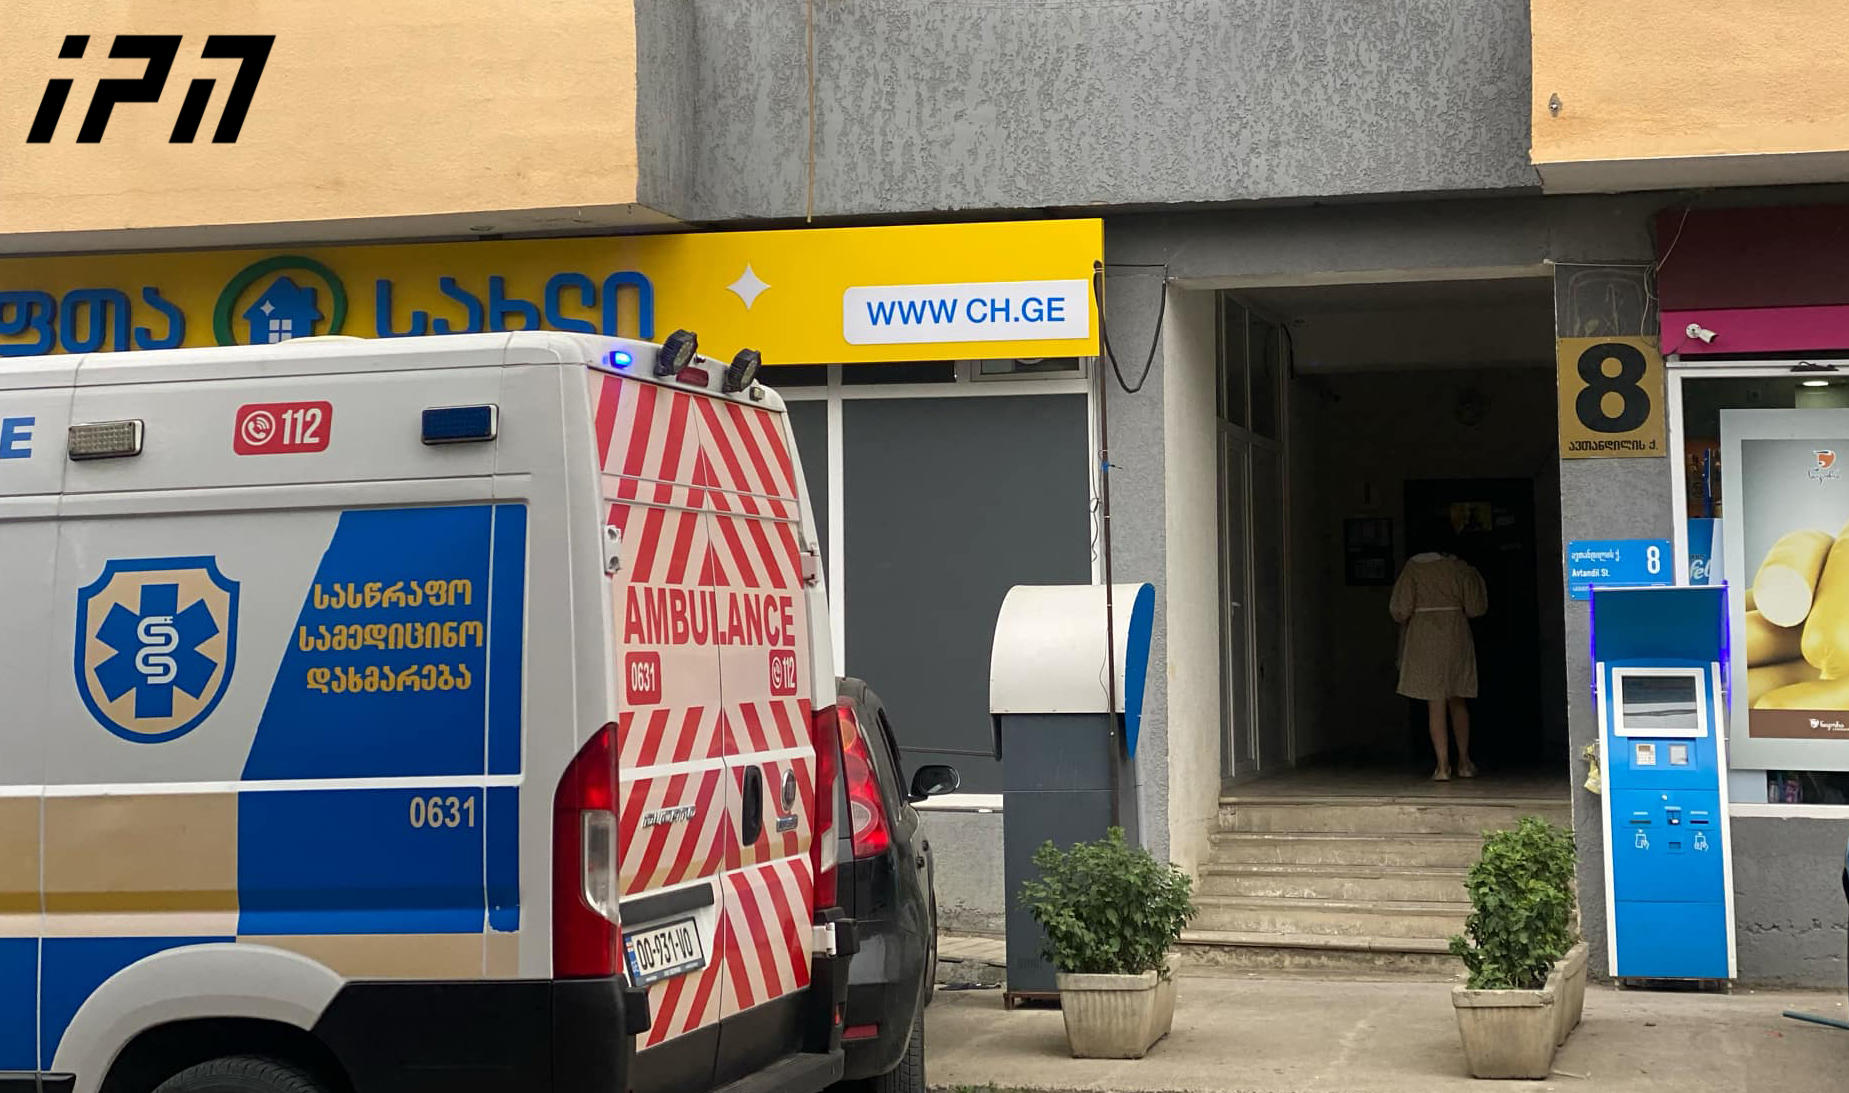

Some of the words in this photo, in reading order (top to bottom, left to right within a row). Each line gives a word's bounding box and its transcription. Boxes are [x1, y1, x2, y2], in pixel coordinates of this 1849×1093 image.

[376, 271, 654, 339] სახლი
[1575, 343, 1651, 433] 8
[281, 408, 322, 445] 112
[1569, 440, 1646, 451] ავთანდილის
[1572, 568, 1600, 577] Avtandil
[1646, 545, 1661, 575] 8
[314, 579, 472, 609] სასწრაფო
[624, 586, 796, 647] AMBULANCE
[299, 621, 484, 652] სამედიცინო
[306, 664, 472, 693] დახმარება
[631, 661, 655, 692] 0631
[782, 656, 796, 689] 112
[409, 796, 475, 828] 0631
